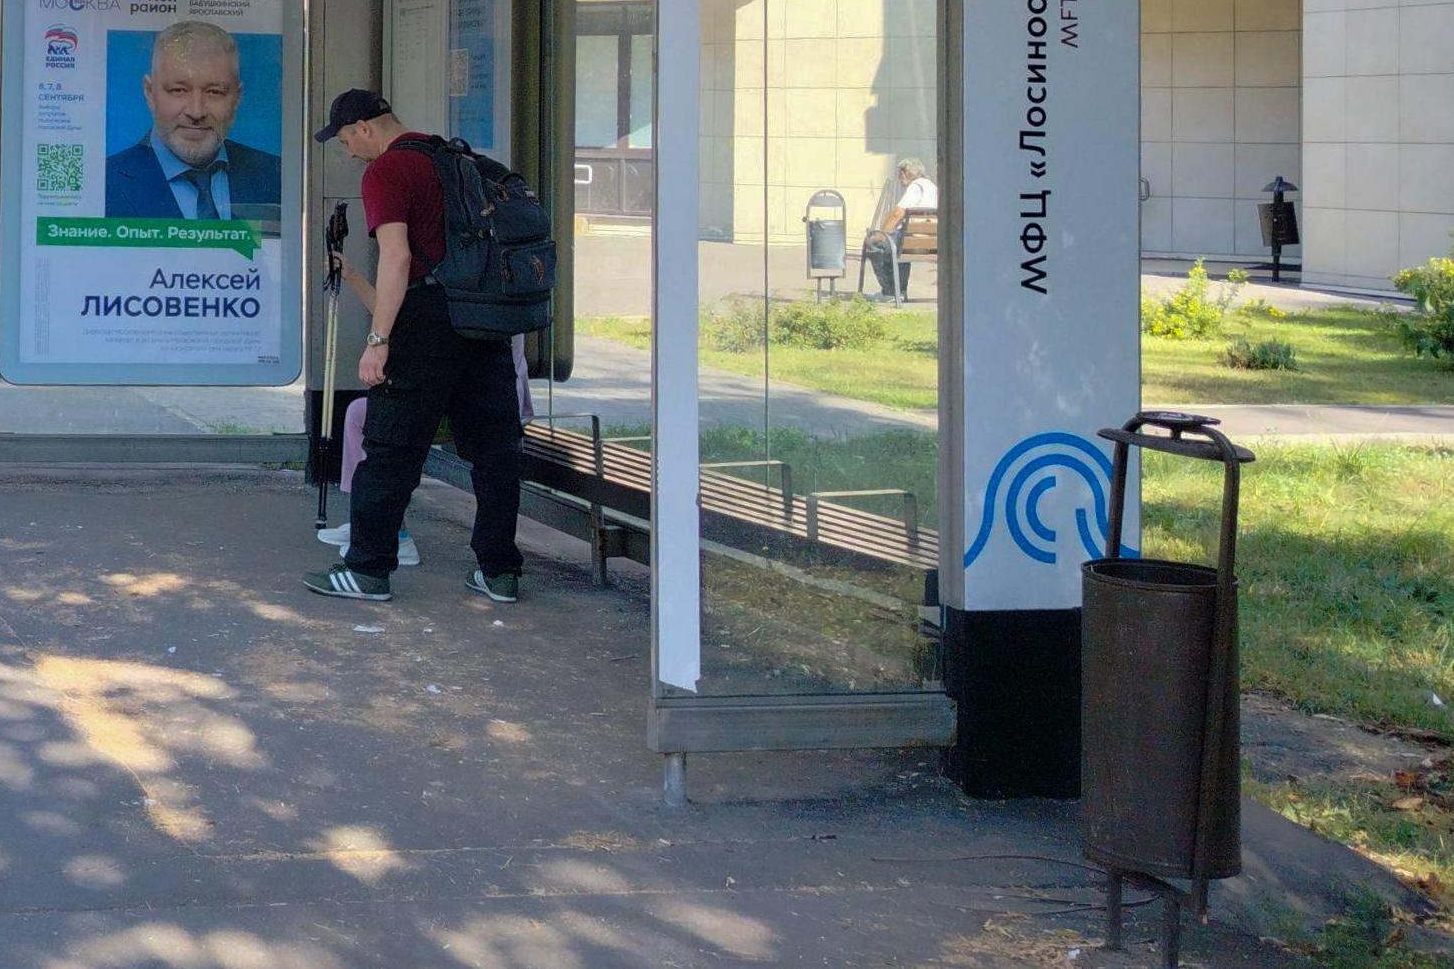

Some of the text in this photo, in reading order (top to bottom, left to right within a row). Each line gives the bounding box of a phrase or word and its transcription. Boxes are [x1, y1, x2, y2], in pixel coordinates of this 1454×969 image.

[38, 94, 84, 102] СЕНТЯБРЯ
[47, 224, 251, 243] Знание. Опыт. Результат.
[1019, 190, 1052, 295] МФЦ
[149, 268, 261, 291] Алексей
[80, 295, 261, 318] ЛИСОВЕНКО
